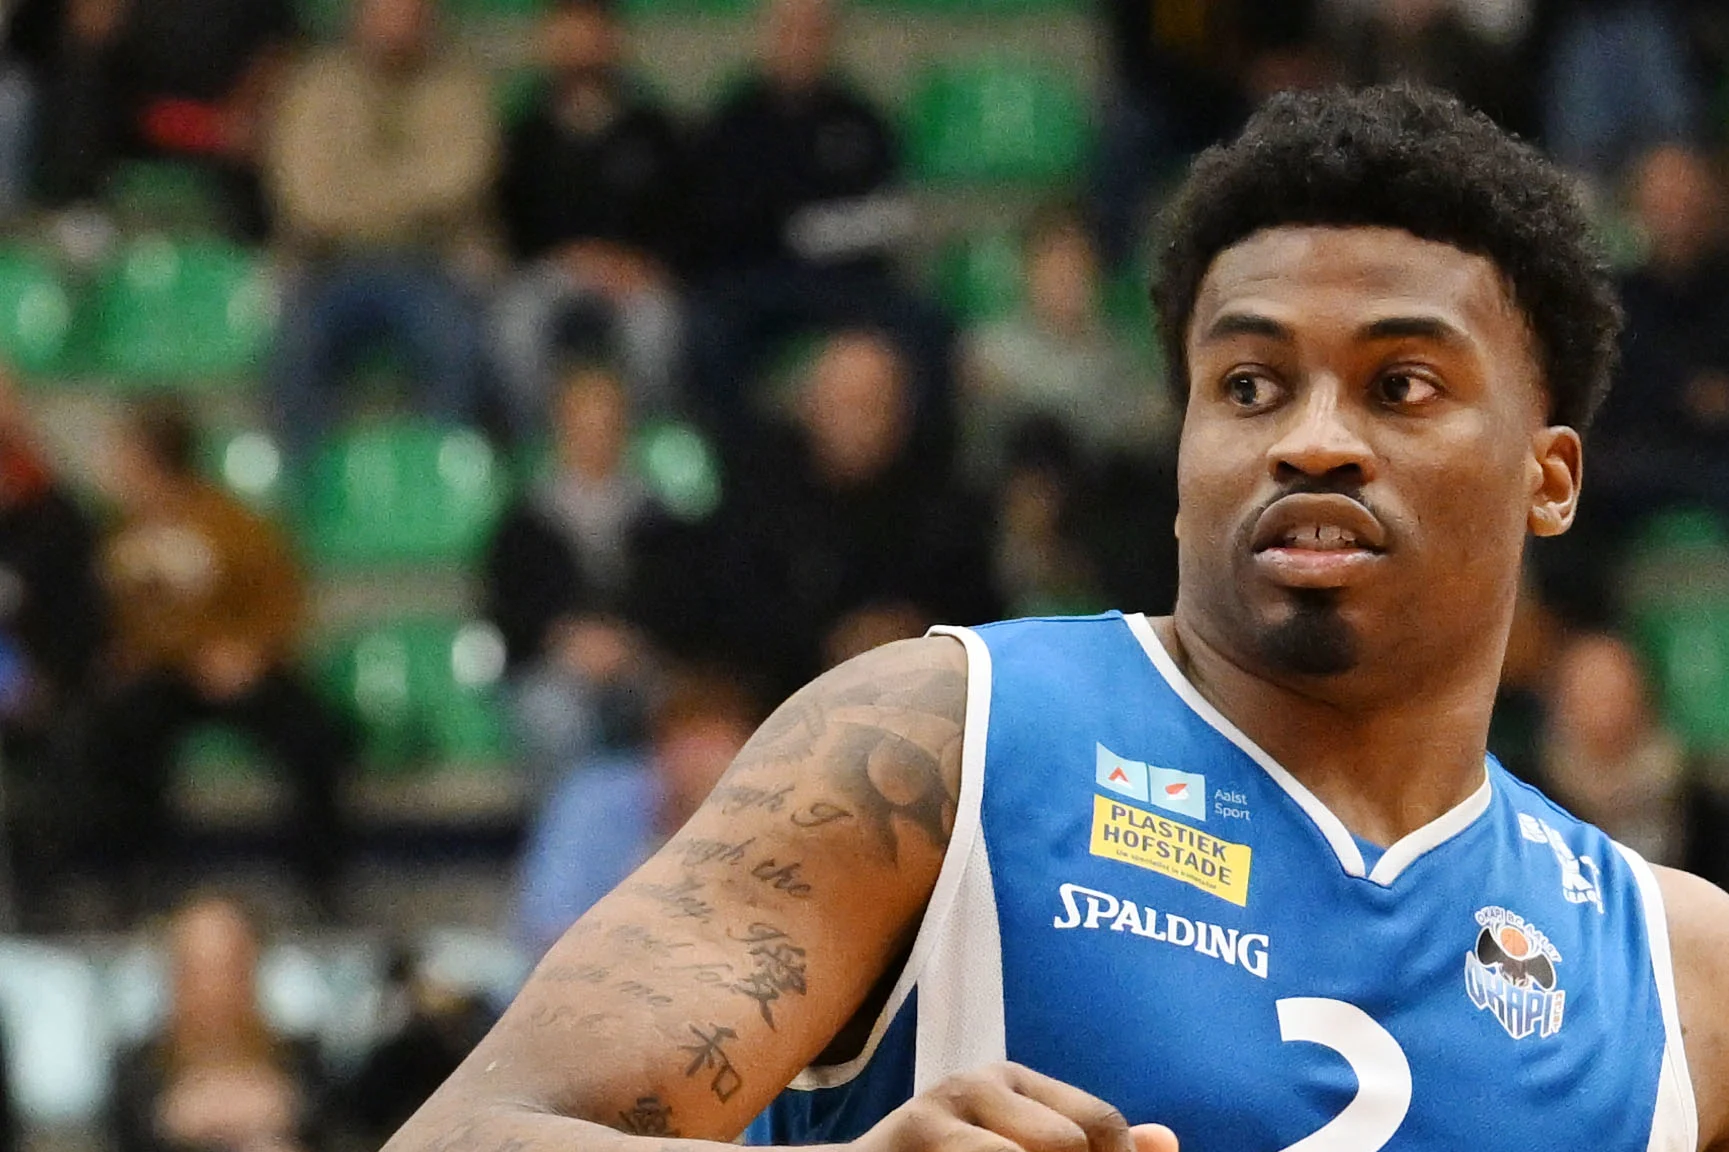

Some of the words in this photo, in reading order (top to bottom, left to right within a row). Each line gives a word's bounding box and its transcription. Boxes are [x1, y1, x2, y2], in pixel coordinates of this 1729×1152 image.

[1214, 788, 1248, 806] Aalst
[1214, 803, 1251, 821] Sport
[1102, 823, 1233, 886] HOFSTADE
[1110, 803, 1228, 862] PLASTIEK
[1053, 882, 1270, 979] SPALDING
[1464, 950, 1553, 1039] OKAPI
